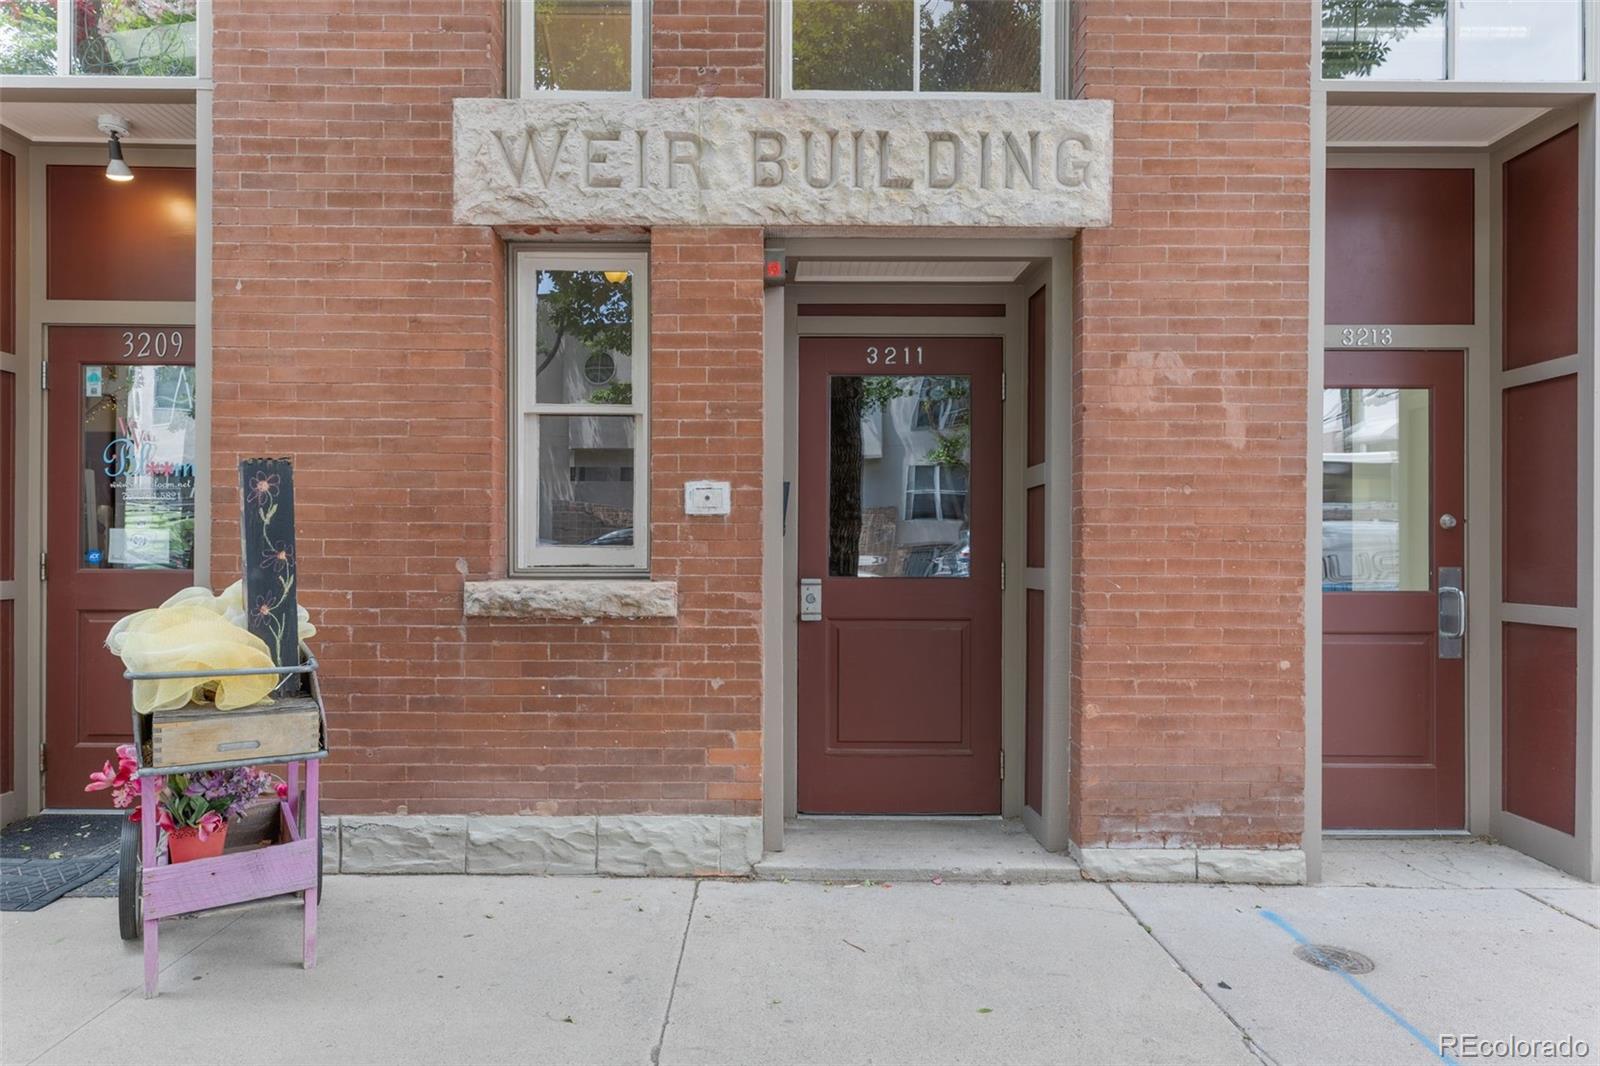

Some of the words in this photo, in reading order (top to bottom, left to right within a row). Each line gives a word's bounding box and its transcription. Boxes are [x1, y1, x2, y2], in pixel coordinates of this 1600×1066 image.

[489, 128, 710, 190] WEIR
[748, 128, 1094, 191] BUILDING
[122, 331, 183, 358] 3209
[1341, 327, 1393, 347] 3213
[866, 346, 924, 365] 3211
